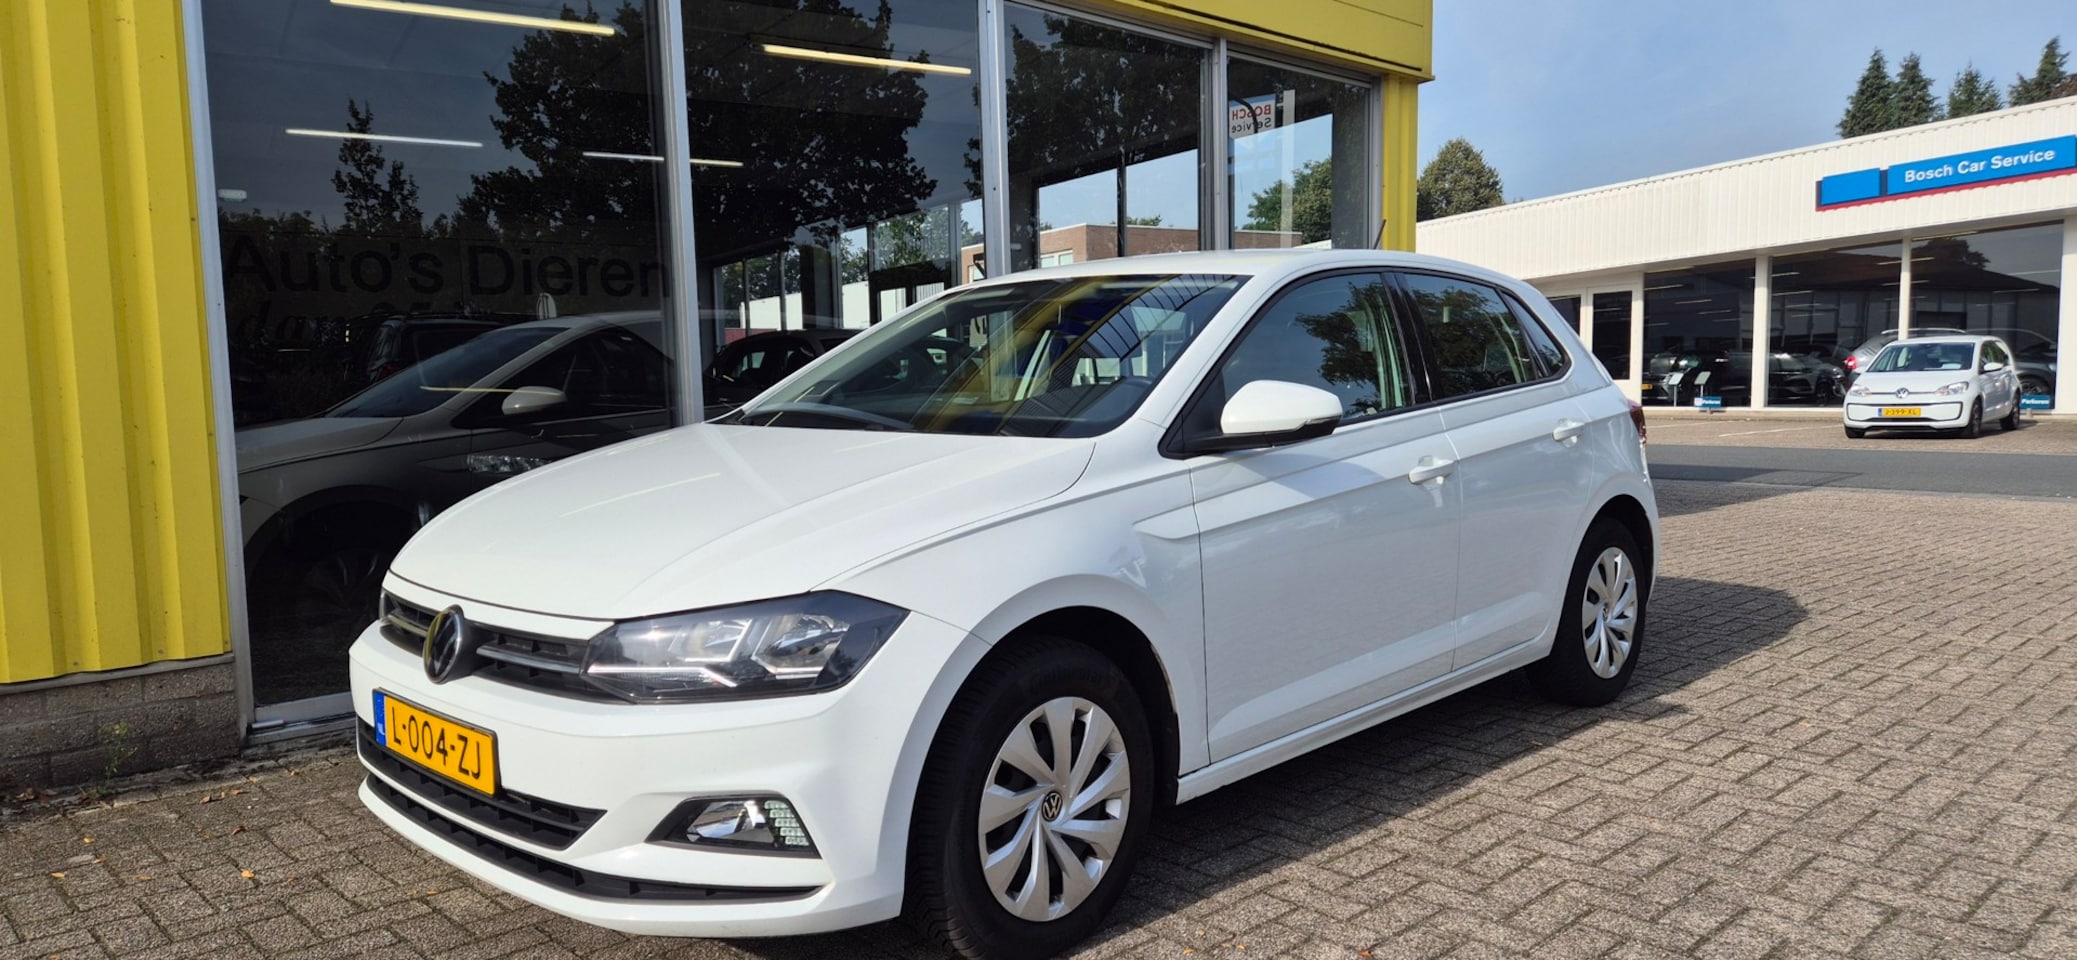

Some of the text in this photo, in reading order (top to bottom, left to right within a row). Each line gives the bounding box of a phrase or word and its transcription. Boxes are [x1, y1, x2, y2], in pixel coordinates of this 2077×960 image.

[1905, 150, 2056, 183] Bosch Car Service
[225, 234, 669, 297] Auto's Dieren
[391, 706, 481, 780] L-004-ZJ
